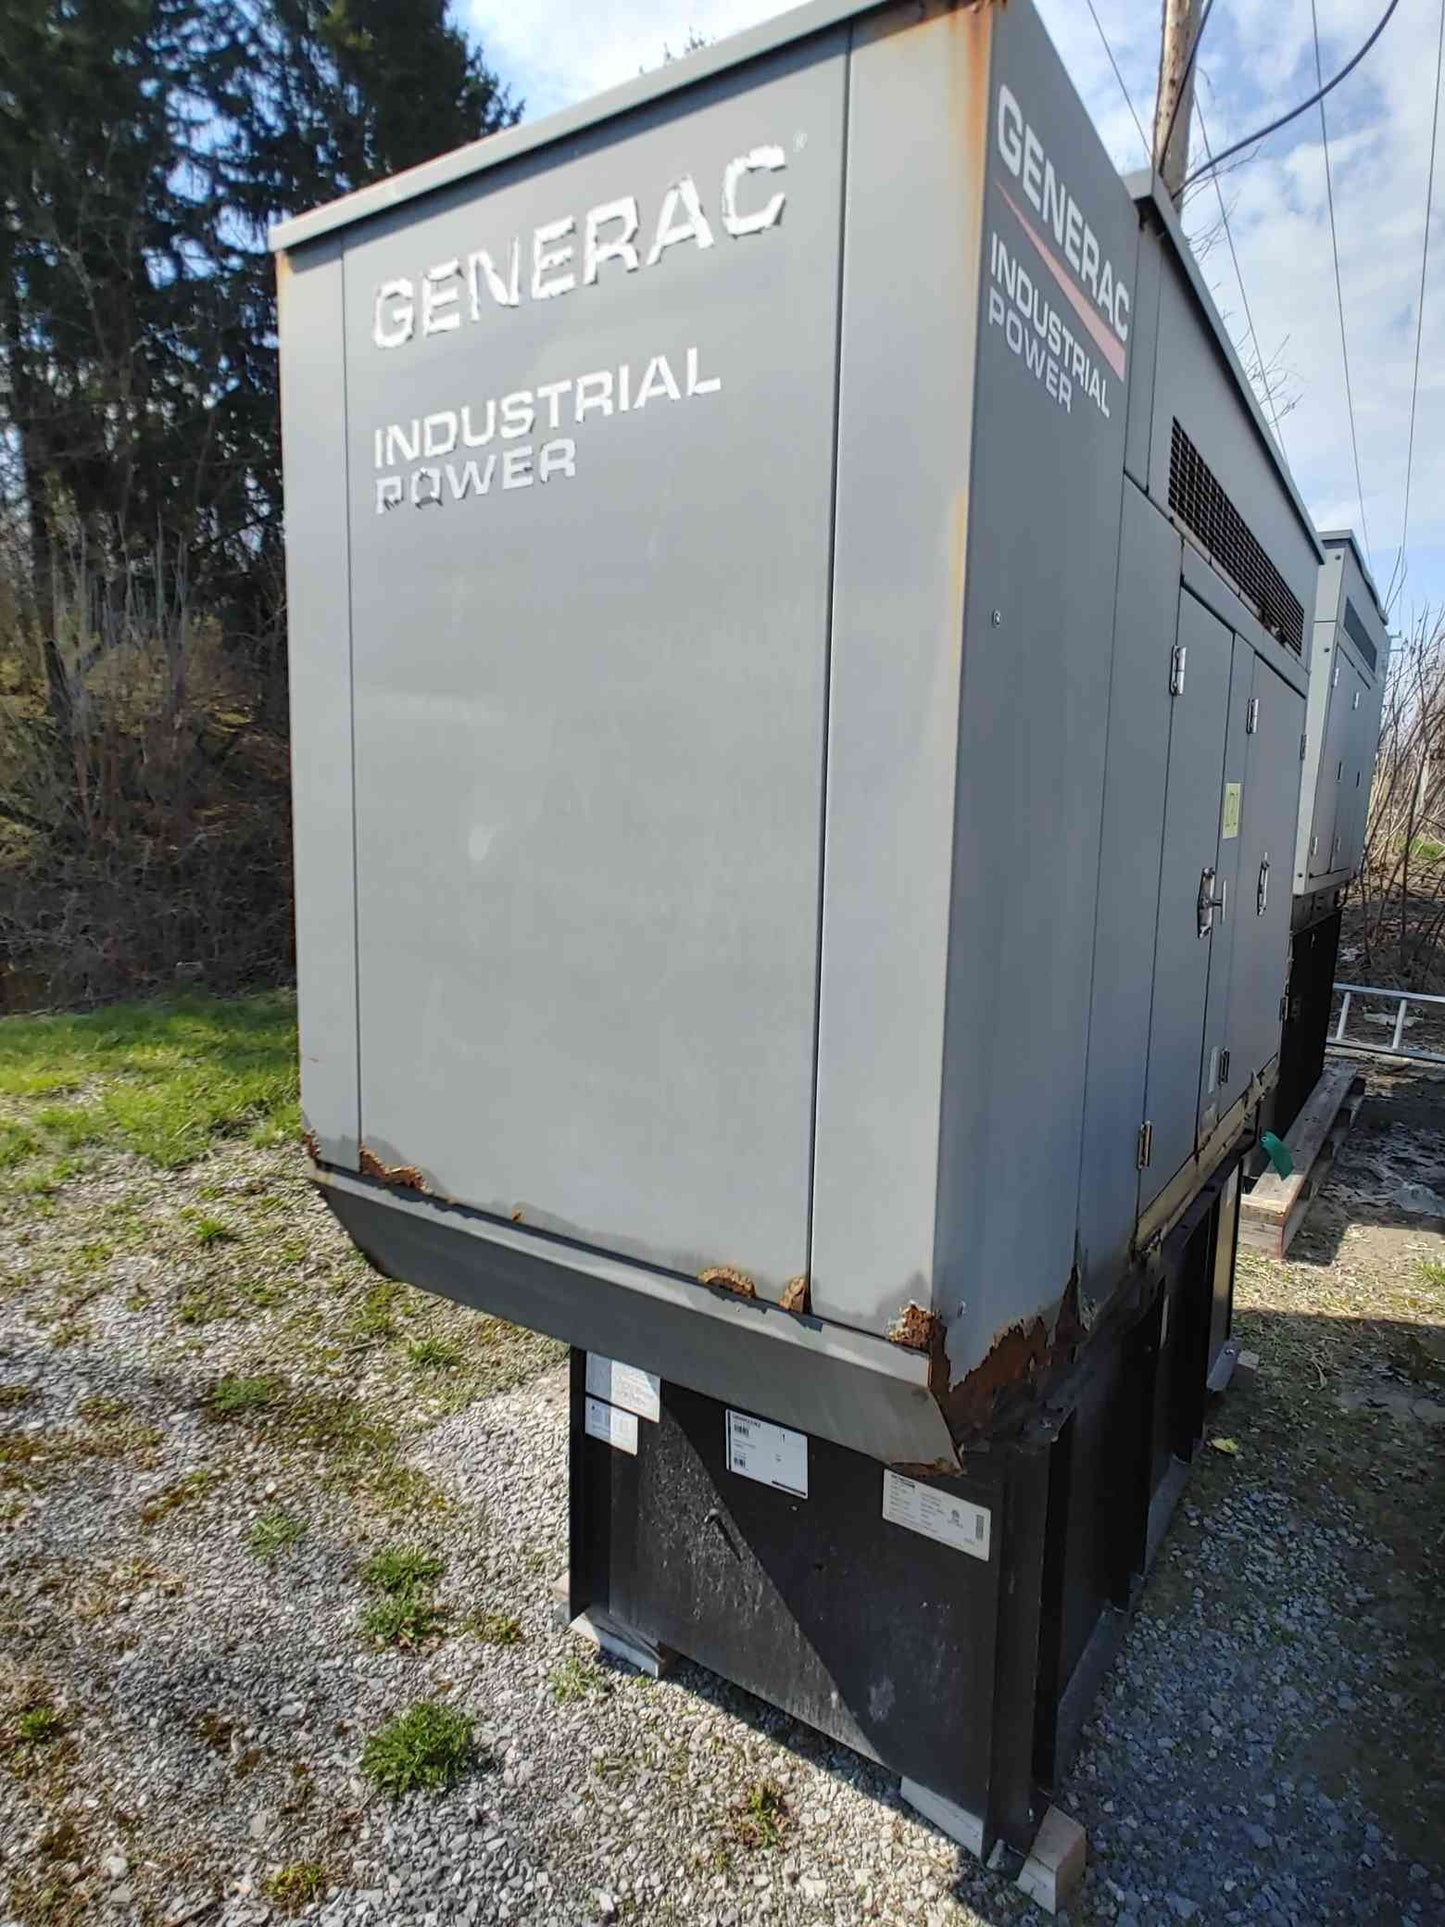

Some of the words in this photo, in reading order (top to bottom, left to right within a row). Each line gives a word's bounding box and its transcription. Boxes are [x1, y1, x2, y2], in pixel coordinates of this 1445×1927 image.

[373, 144, 787, 349] GENERAC
[998, 84, 1129, 342] GENERAC
[989, 287, 1073, 414] POWER
[991, 232, 1110, 418] INDUSTRIAL
[374, 347, 721, 469] INDUSTRIAL
[375, 437, 577, 515] POWER
